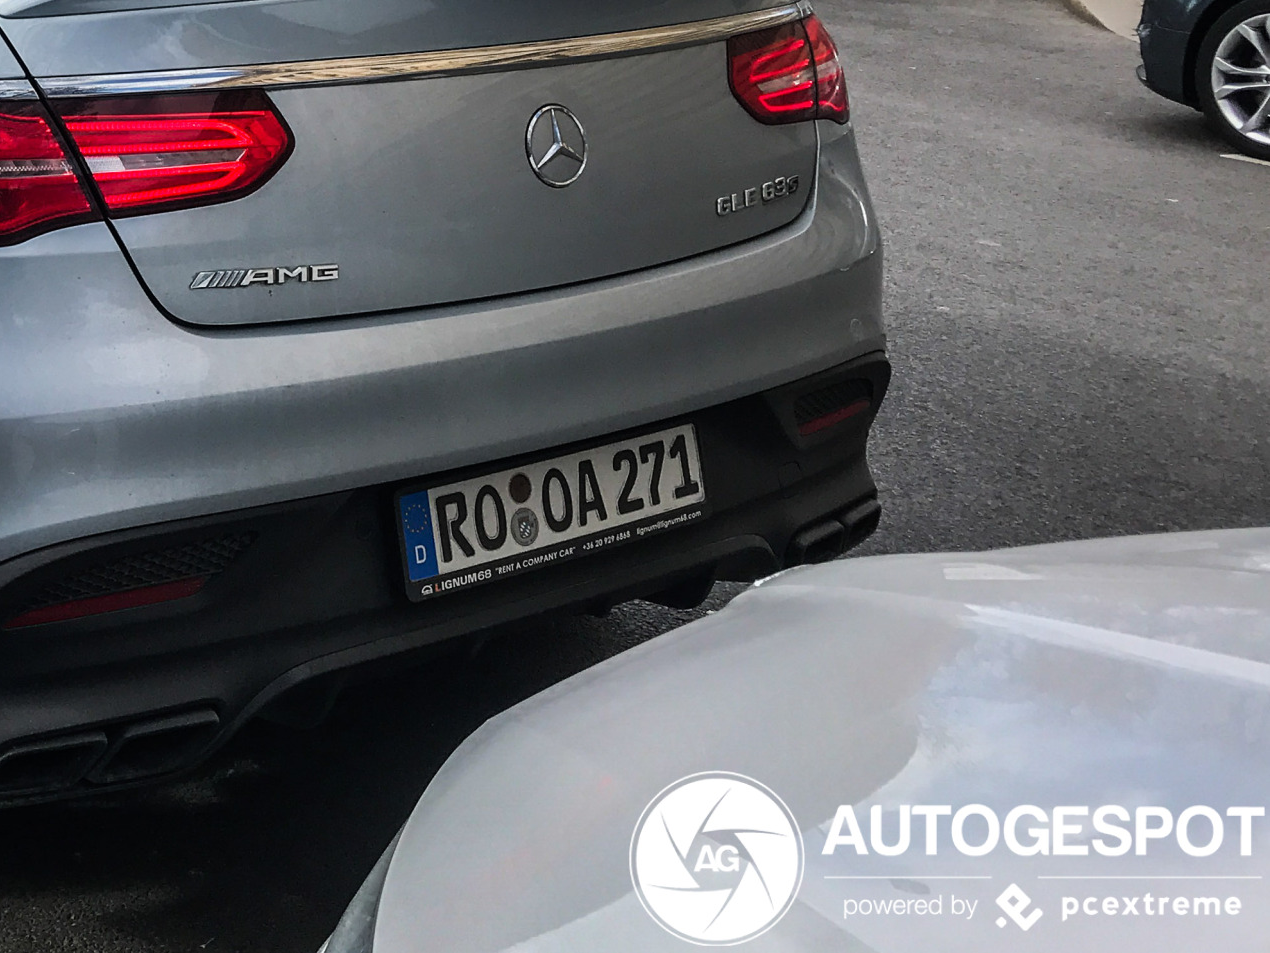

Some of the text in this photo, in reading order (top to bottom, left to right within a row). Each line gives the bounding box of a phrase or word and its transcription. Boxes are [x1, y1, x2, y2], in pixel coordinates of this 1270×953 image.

[716, 187, 758, 215] GLE
[240, 264, 339, 286] AMG
[415, 434, 700, 565] D RO OA 271
[434, 569, 492, 593] LIGNUM68
[522, 551, 557, 567] COMPANY
[595, 538, 603, 548] 20
[604, 535, 615, 545] 929
